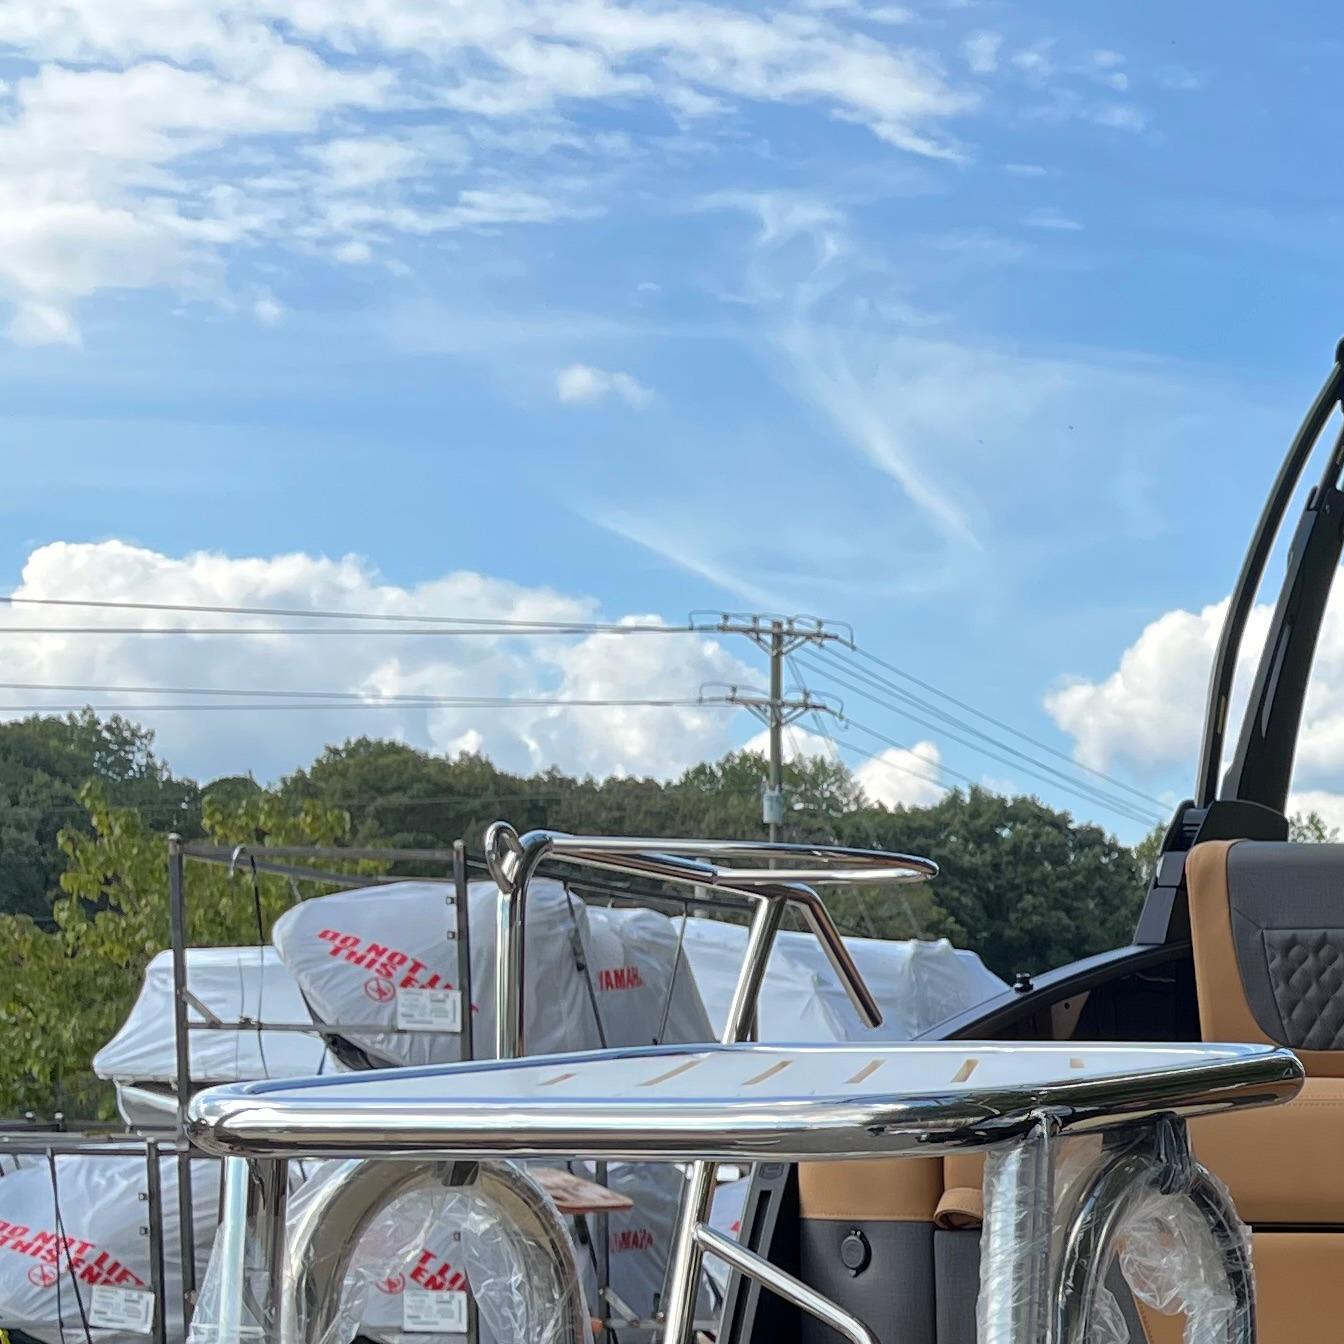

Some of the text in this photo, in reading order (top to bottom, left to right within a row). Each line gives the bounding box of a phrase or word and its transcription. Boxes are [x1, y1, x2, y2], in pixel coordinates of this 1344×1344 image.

[329, 945, 397, 979] THIS
[366, 943, 428, 976] NOT
[66, 1256, 116, 1286] EN
